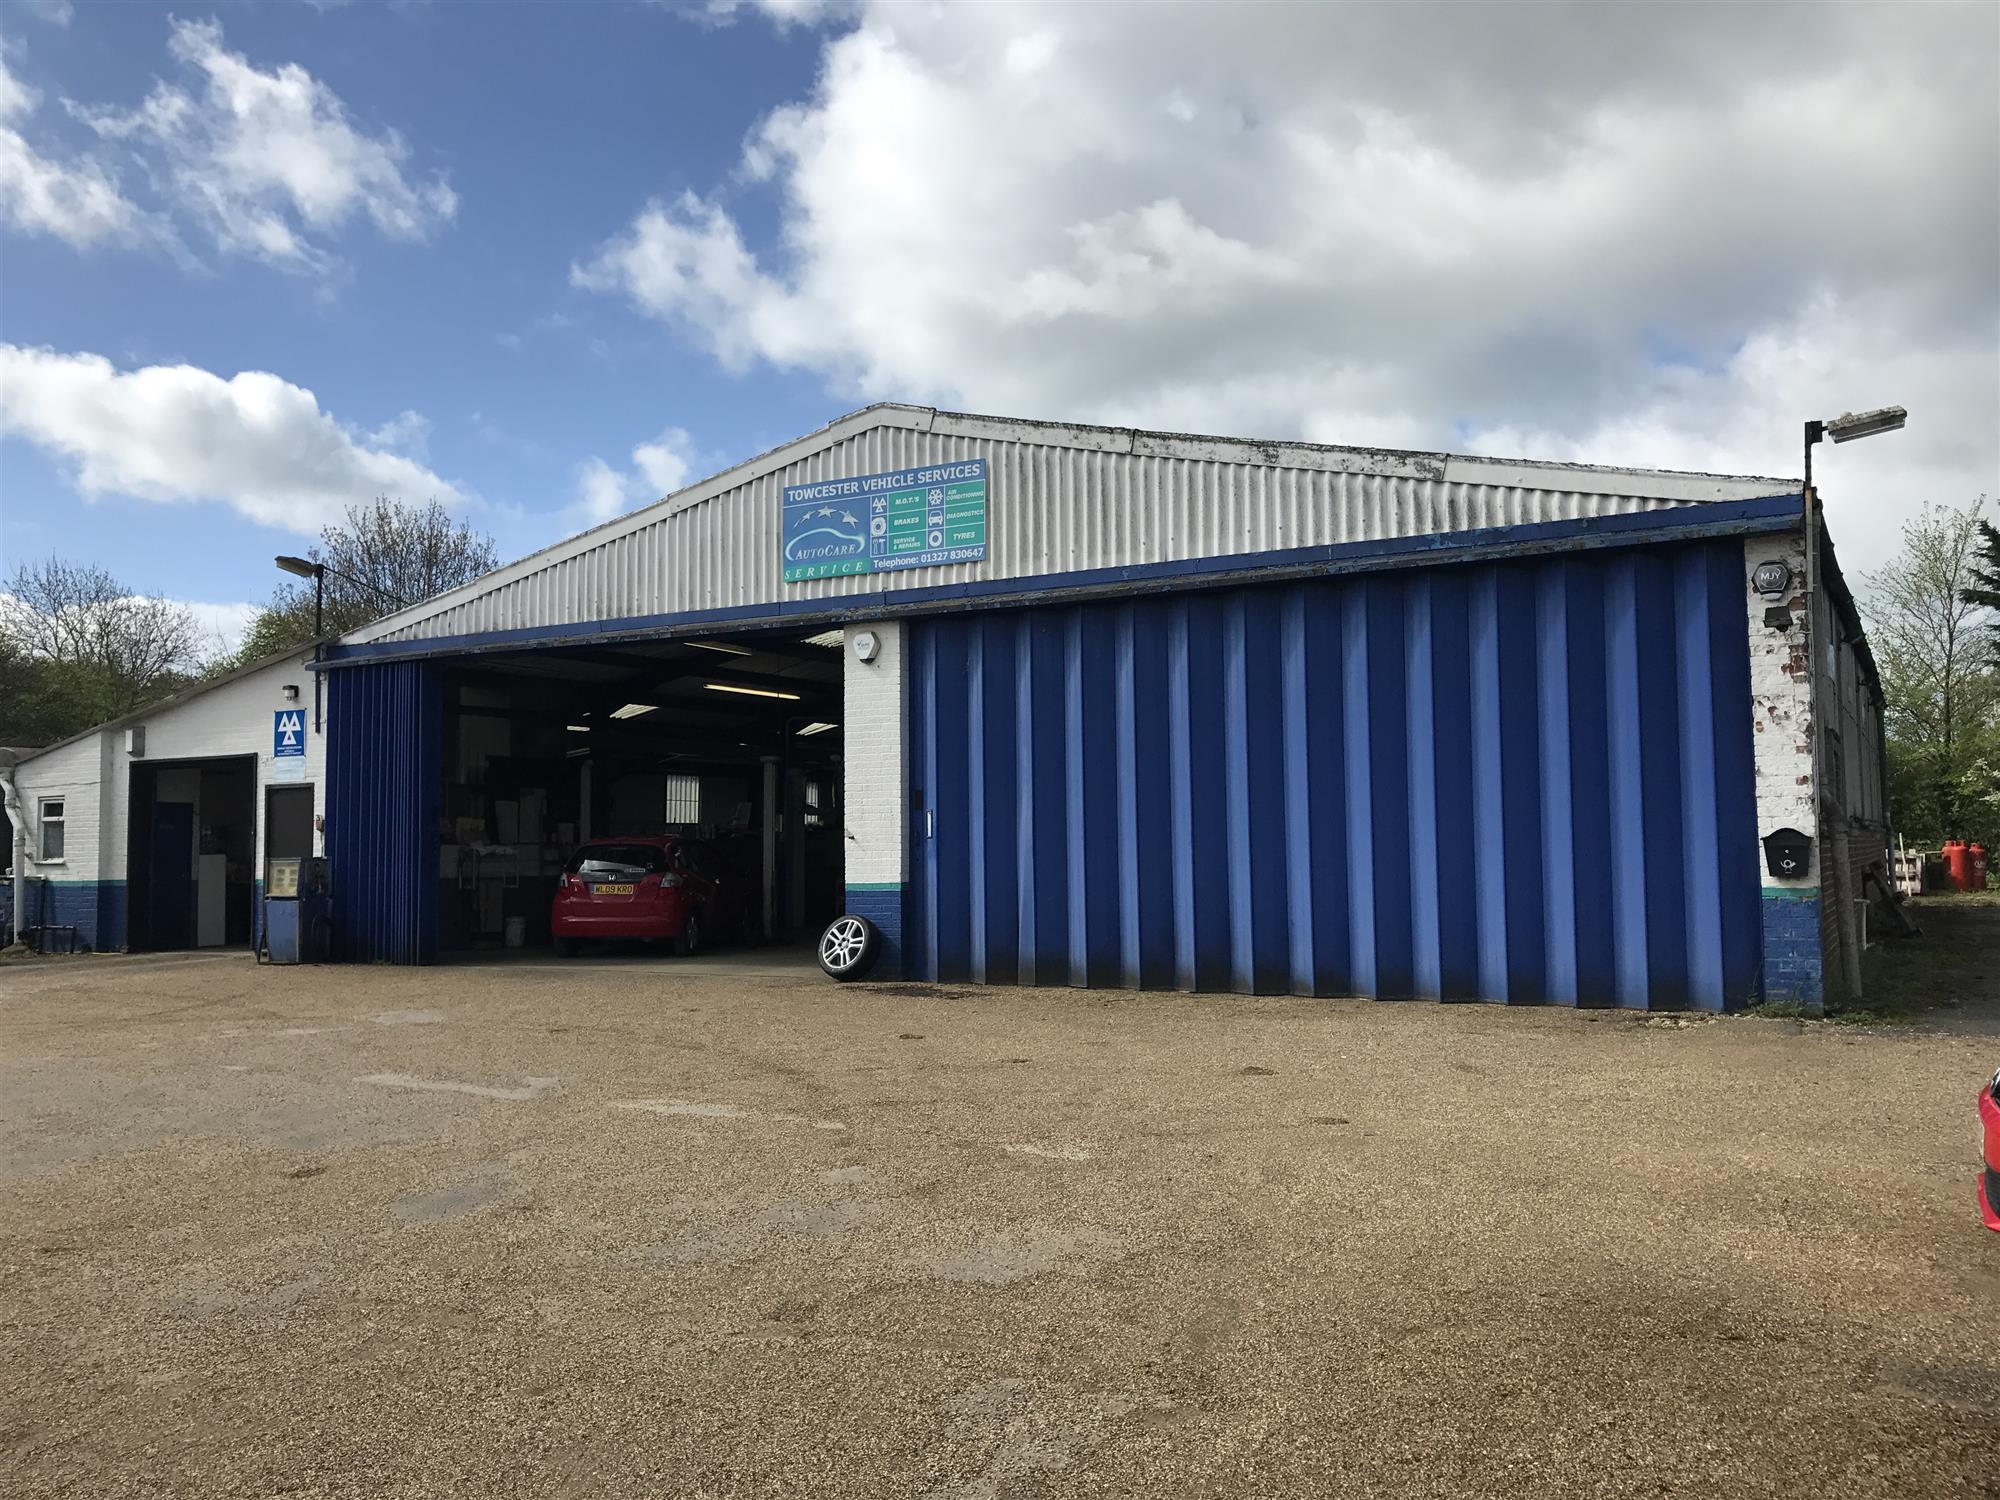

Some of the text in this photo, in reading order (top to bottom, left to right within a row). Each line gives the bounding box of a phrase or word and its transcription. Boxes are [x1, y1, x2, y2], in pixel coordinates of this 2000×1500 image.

[788, 463, 981, 502] TOWCESTER VEHICLE SERVICES
[946, 490, 984, 501] CONDITIONING
[946, 509, 984, 520] DIAGNOSTICS
[893, 517, 920, 526] BRAKES
[893, 536, 916, 545] SERVICE
[952, 531, 976, 541] TYRES
[898, 541, 921, 550] REPAIRS
[873, 547, 984, 569] Telephone: 01327 830647
[784, 561, 863, 580] SERVICE
